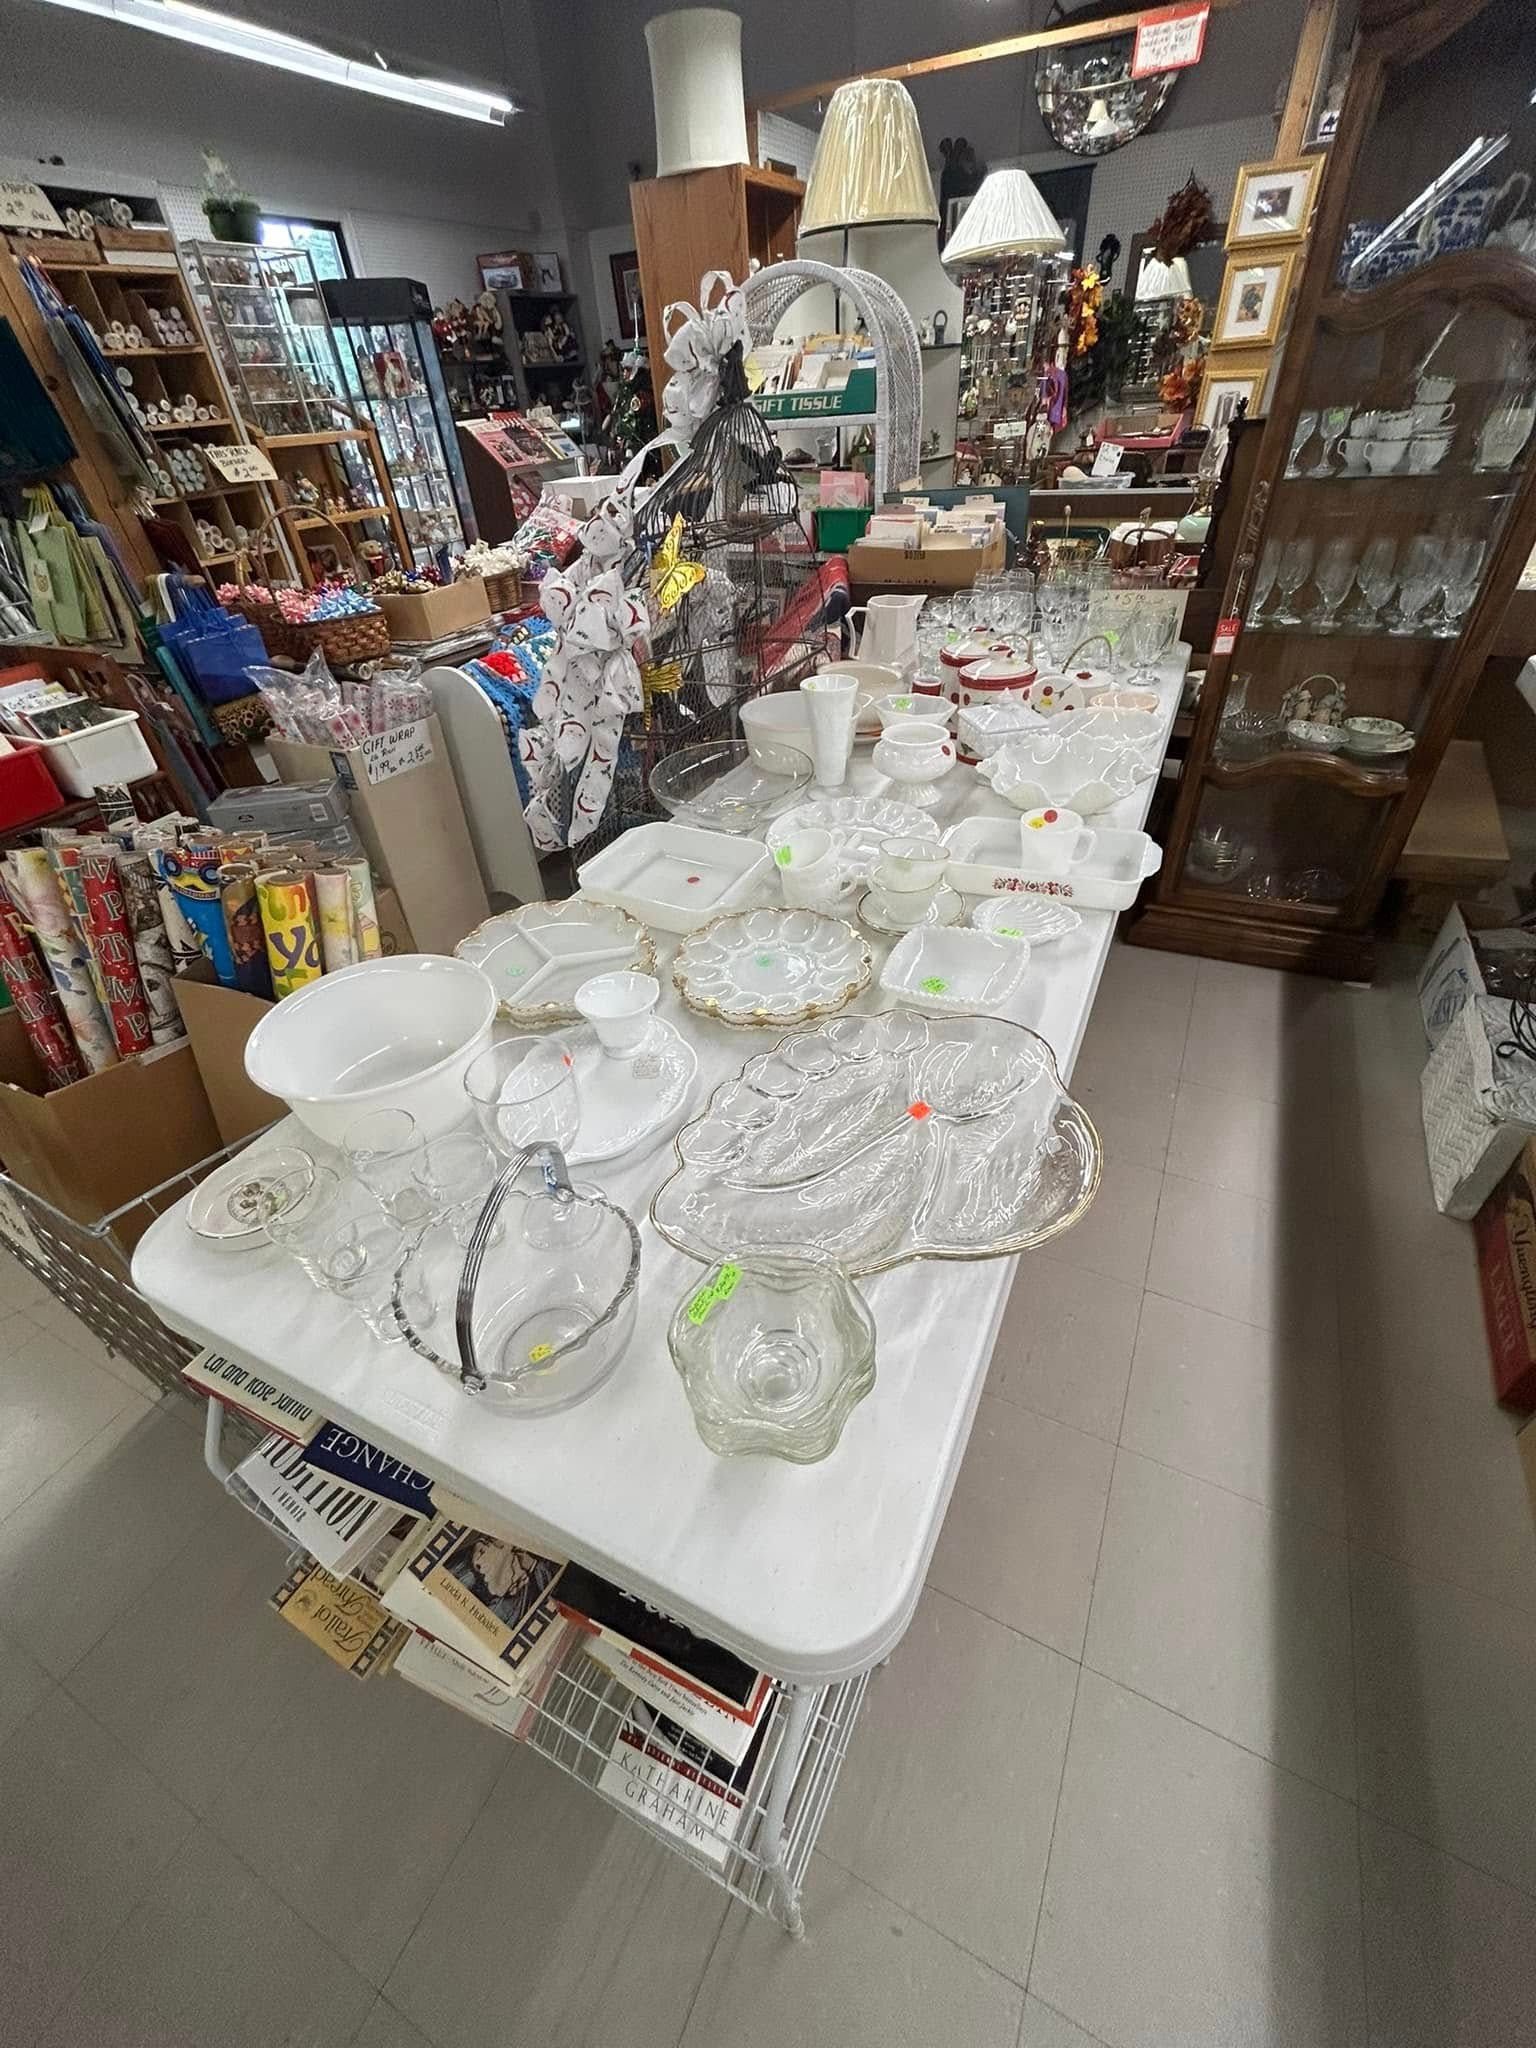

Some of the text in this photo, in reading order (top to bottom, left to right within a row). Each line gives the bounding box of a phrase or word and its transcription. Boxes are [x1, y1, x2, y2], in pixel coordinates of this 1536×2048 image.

[790, 395, 842, 411] TISSUE
[1220, 623, 1237, 633] SALE
[363, 726, 416, 755] GIFT WRAP
[320, 1428, 436, 1491] CHANGE
[279, 1490, 307, 1523] MEMOIR
[440, 1577, 461, 1601] Linda
[620, 1751, 730, 1828] KATHARINE
[625, 1780, 706, 1841] GRAHAM
